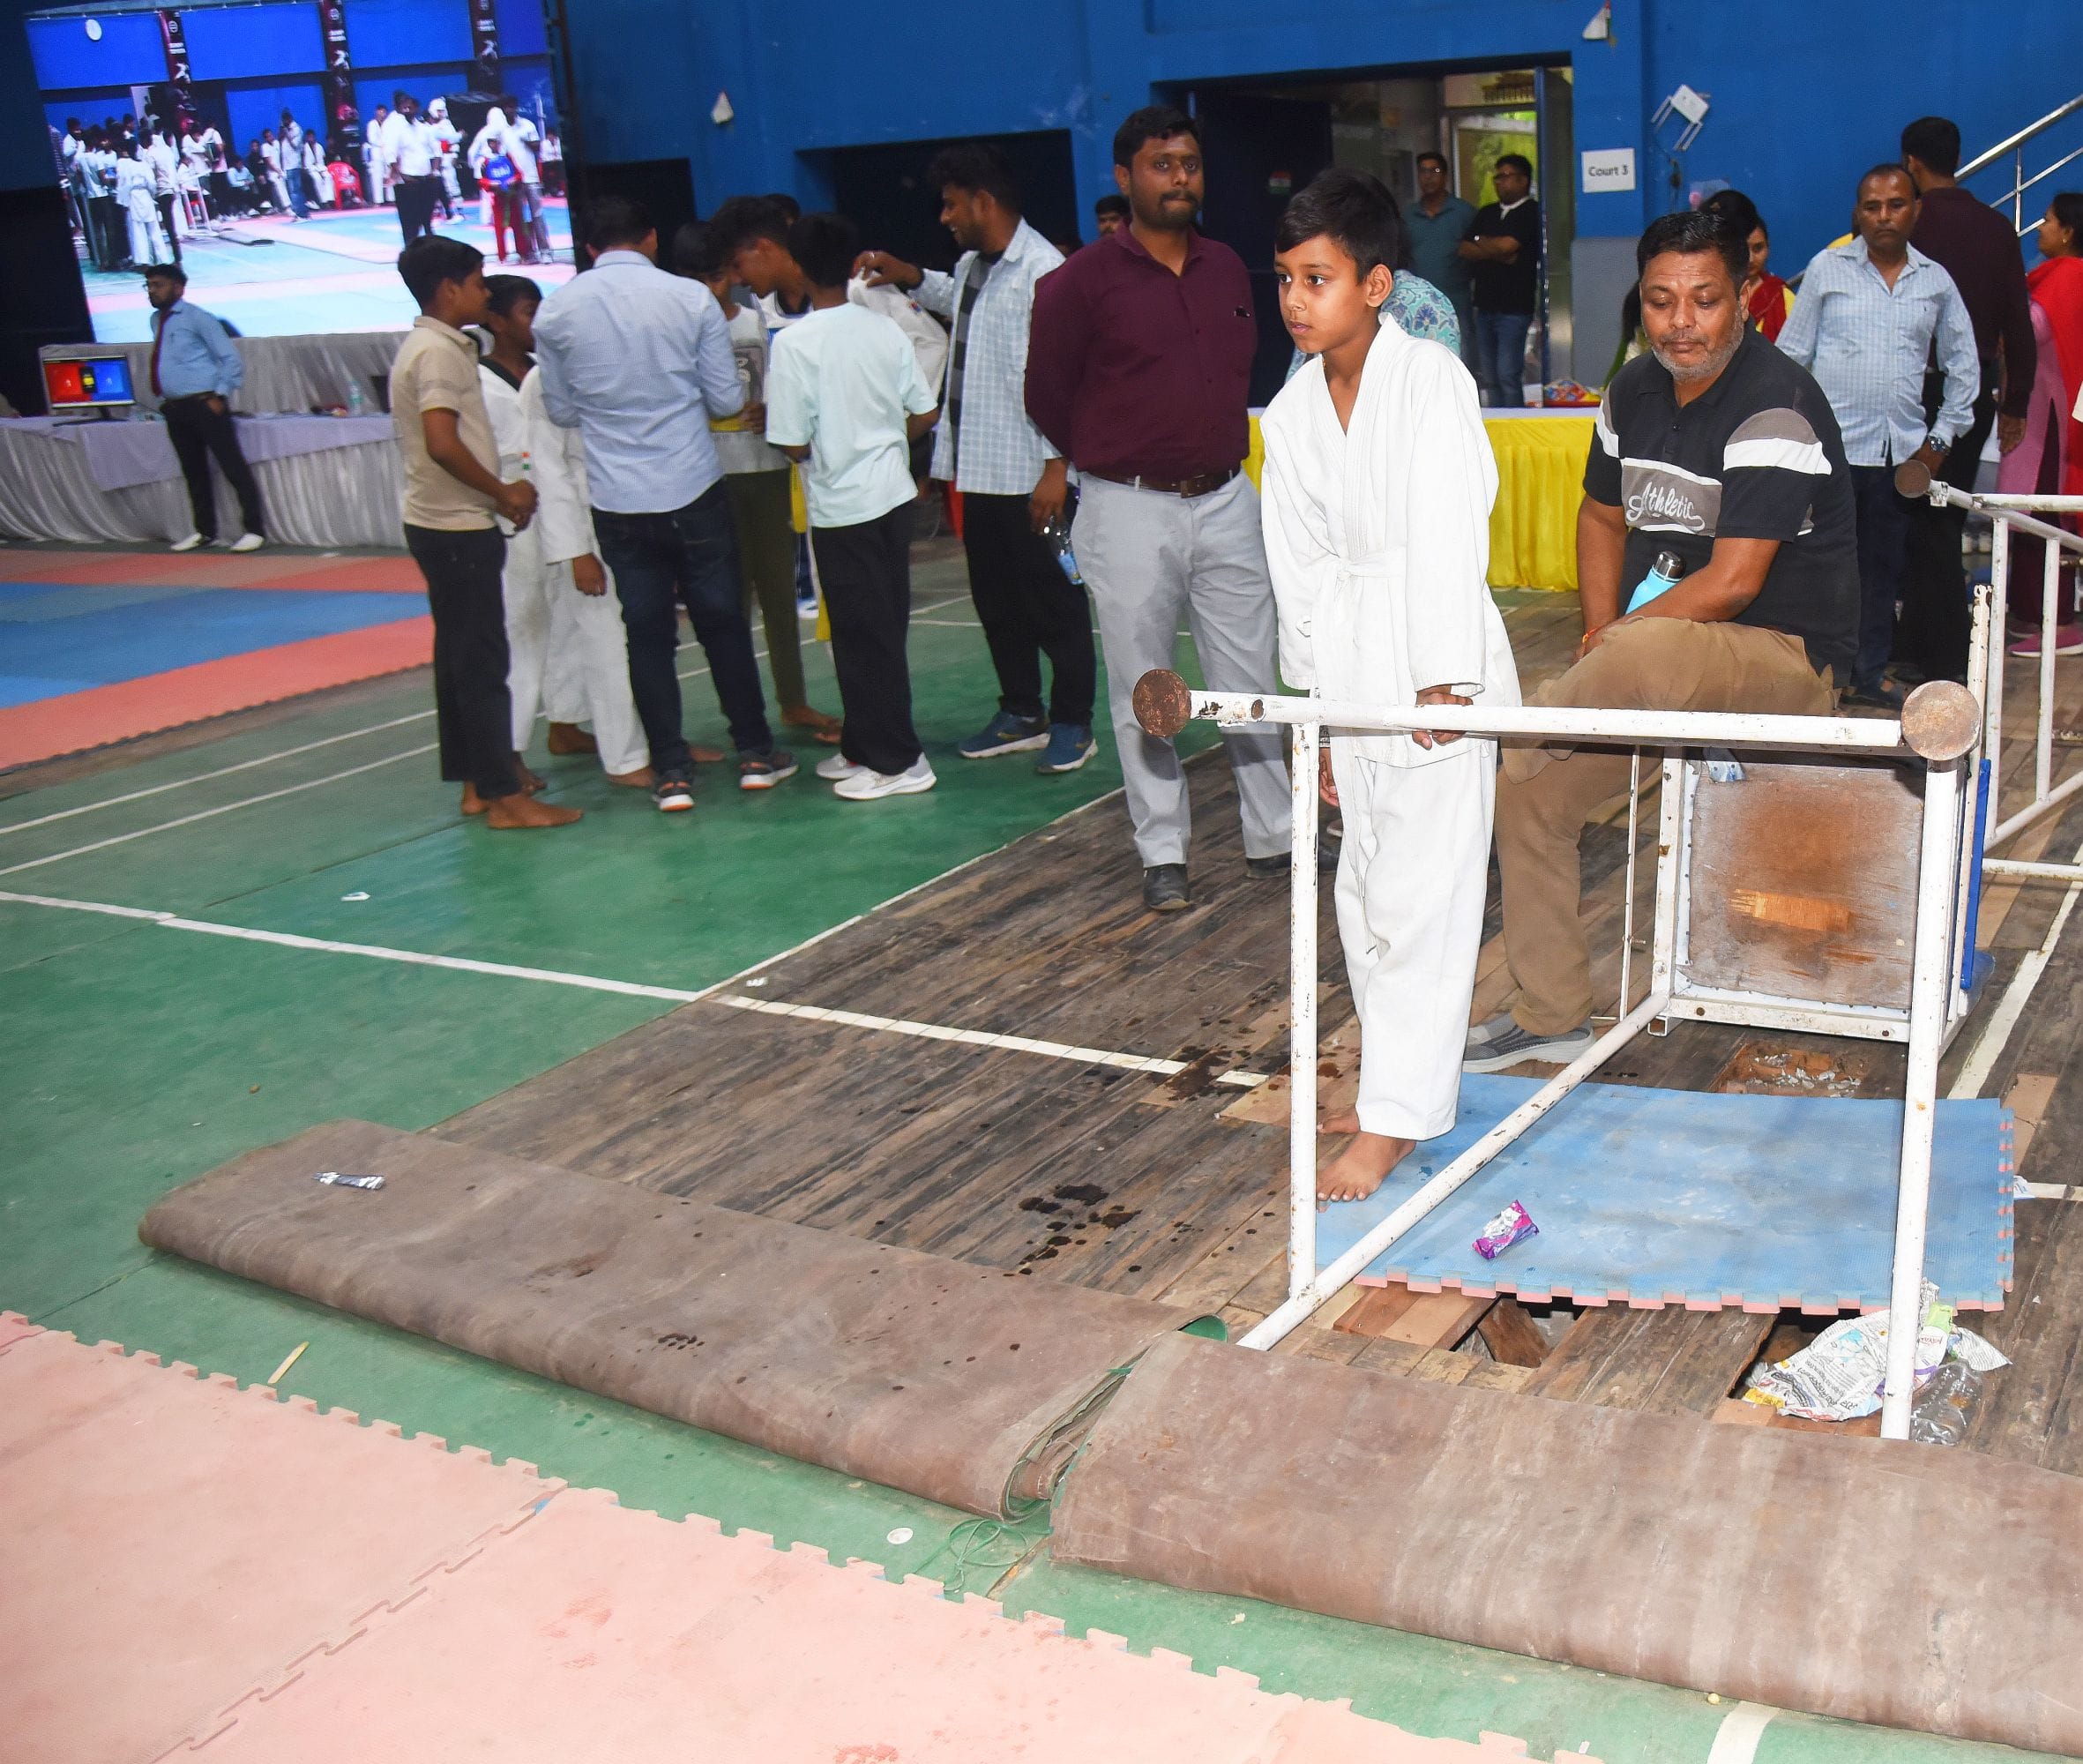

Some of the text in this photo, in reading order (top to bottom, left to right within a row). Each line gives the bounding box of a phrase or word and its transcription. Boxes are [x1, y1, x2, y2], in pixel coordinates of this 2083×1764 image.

[1588, 165, 1629, 177] Court 3
[1626, 482, 1706, 531] Athletic
